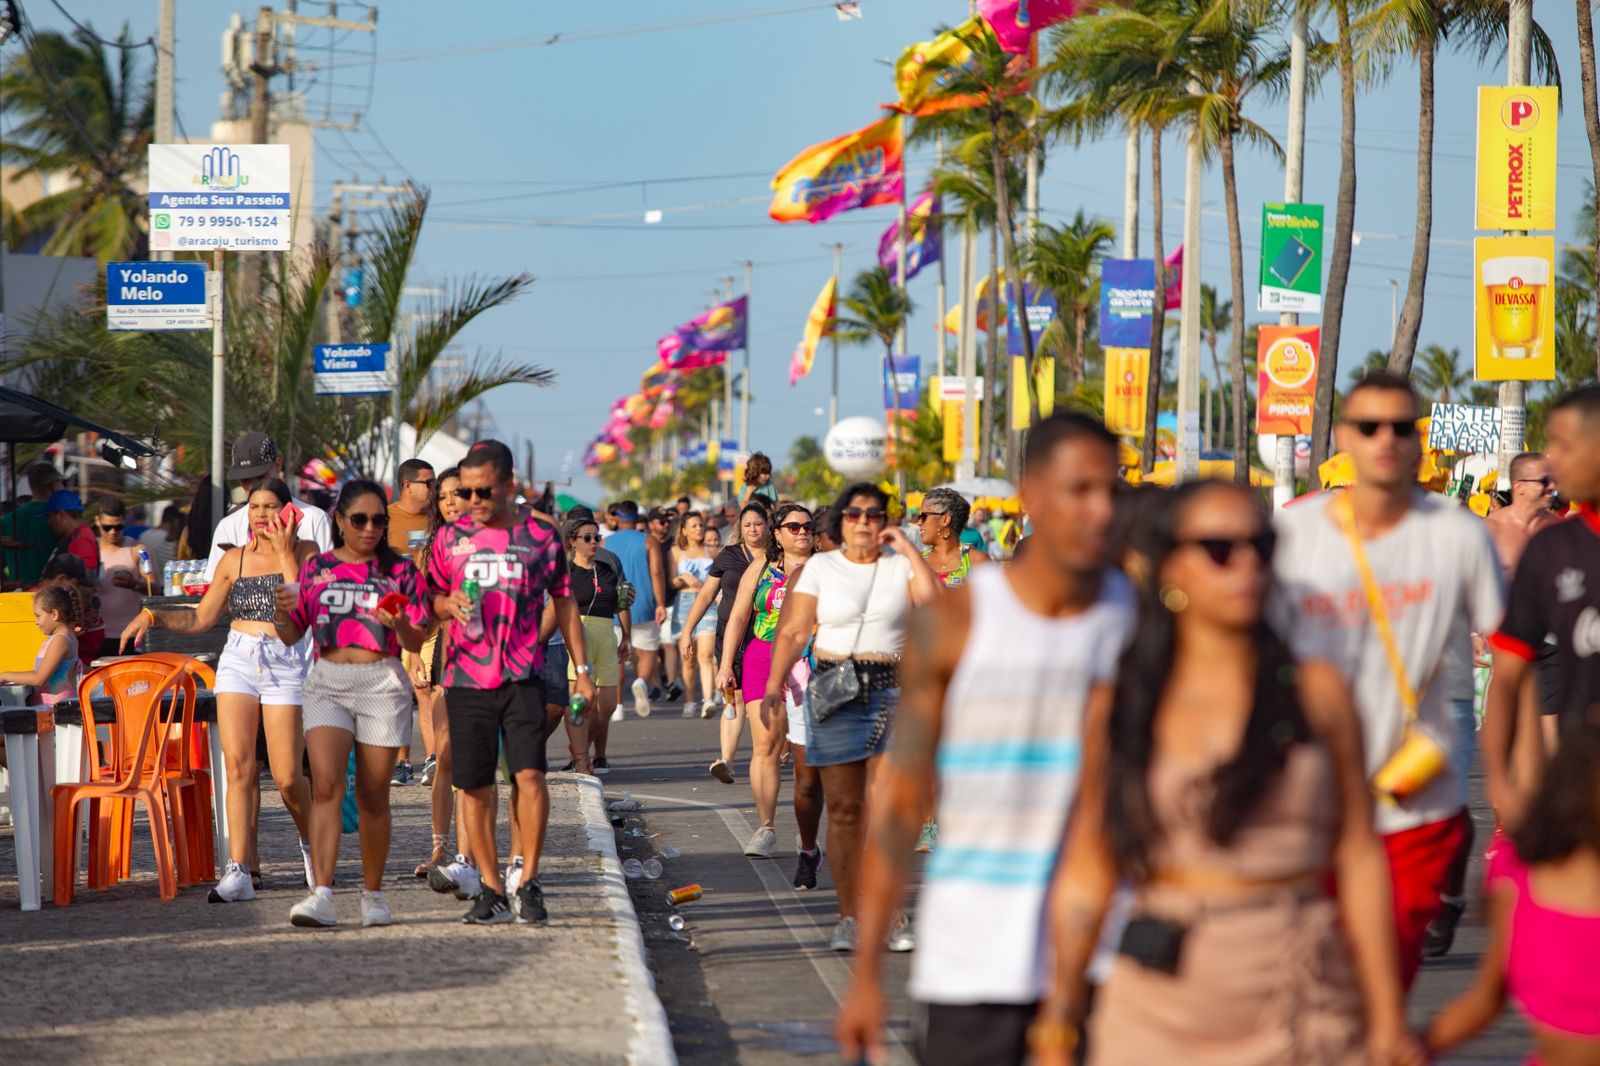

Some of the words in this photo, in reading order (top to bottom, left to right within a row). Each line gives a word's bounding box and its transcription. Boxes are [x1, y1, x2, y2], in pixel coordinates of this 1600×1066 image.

[1507, 143, 1523, 218] PETROX
[160, 195, 208, 207] Agende
[211, 195, 233, 205] Seu
[236, 194, 284, 205] Passeio
[179, 216, 194, 227] 79
[198, 216, 206, 227] 9
[209, 216, 278, 227] 9950-1524
[178, 236, 279, 247] @aracaju_turismo
[120, 269, 189, 283] Yolando
[121, 286, 163, 300] Melo
[1495, 293, 1536, 305] DEVASSA
[322, 346, 372, 358] Yolando
[322, 358, 358, 370] Vieira
[1268, 404, 1311, 417] PIPOCA
[1432, 402, 1502, 423] AMSTEL
[1430, 419, 1500, 441] DEVASSA
[1429, 434, 1494, 454] HEINEKEN
